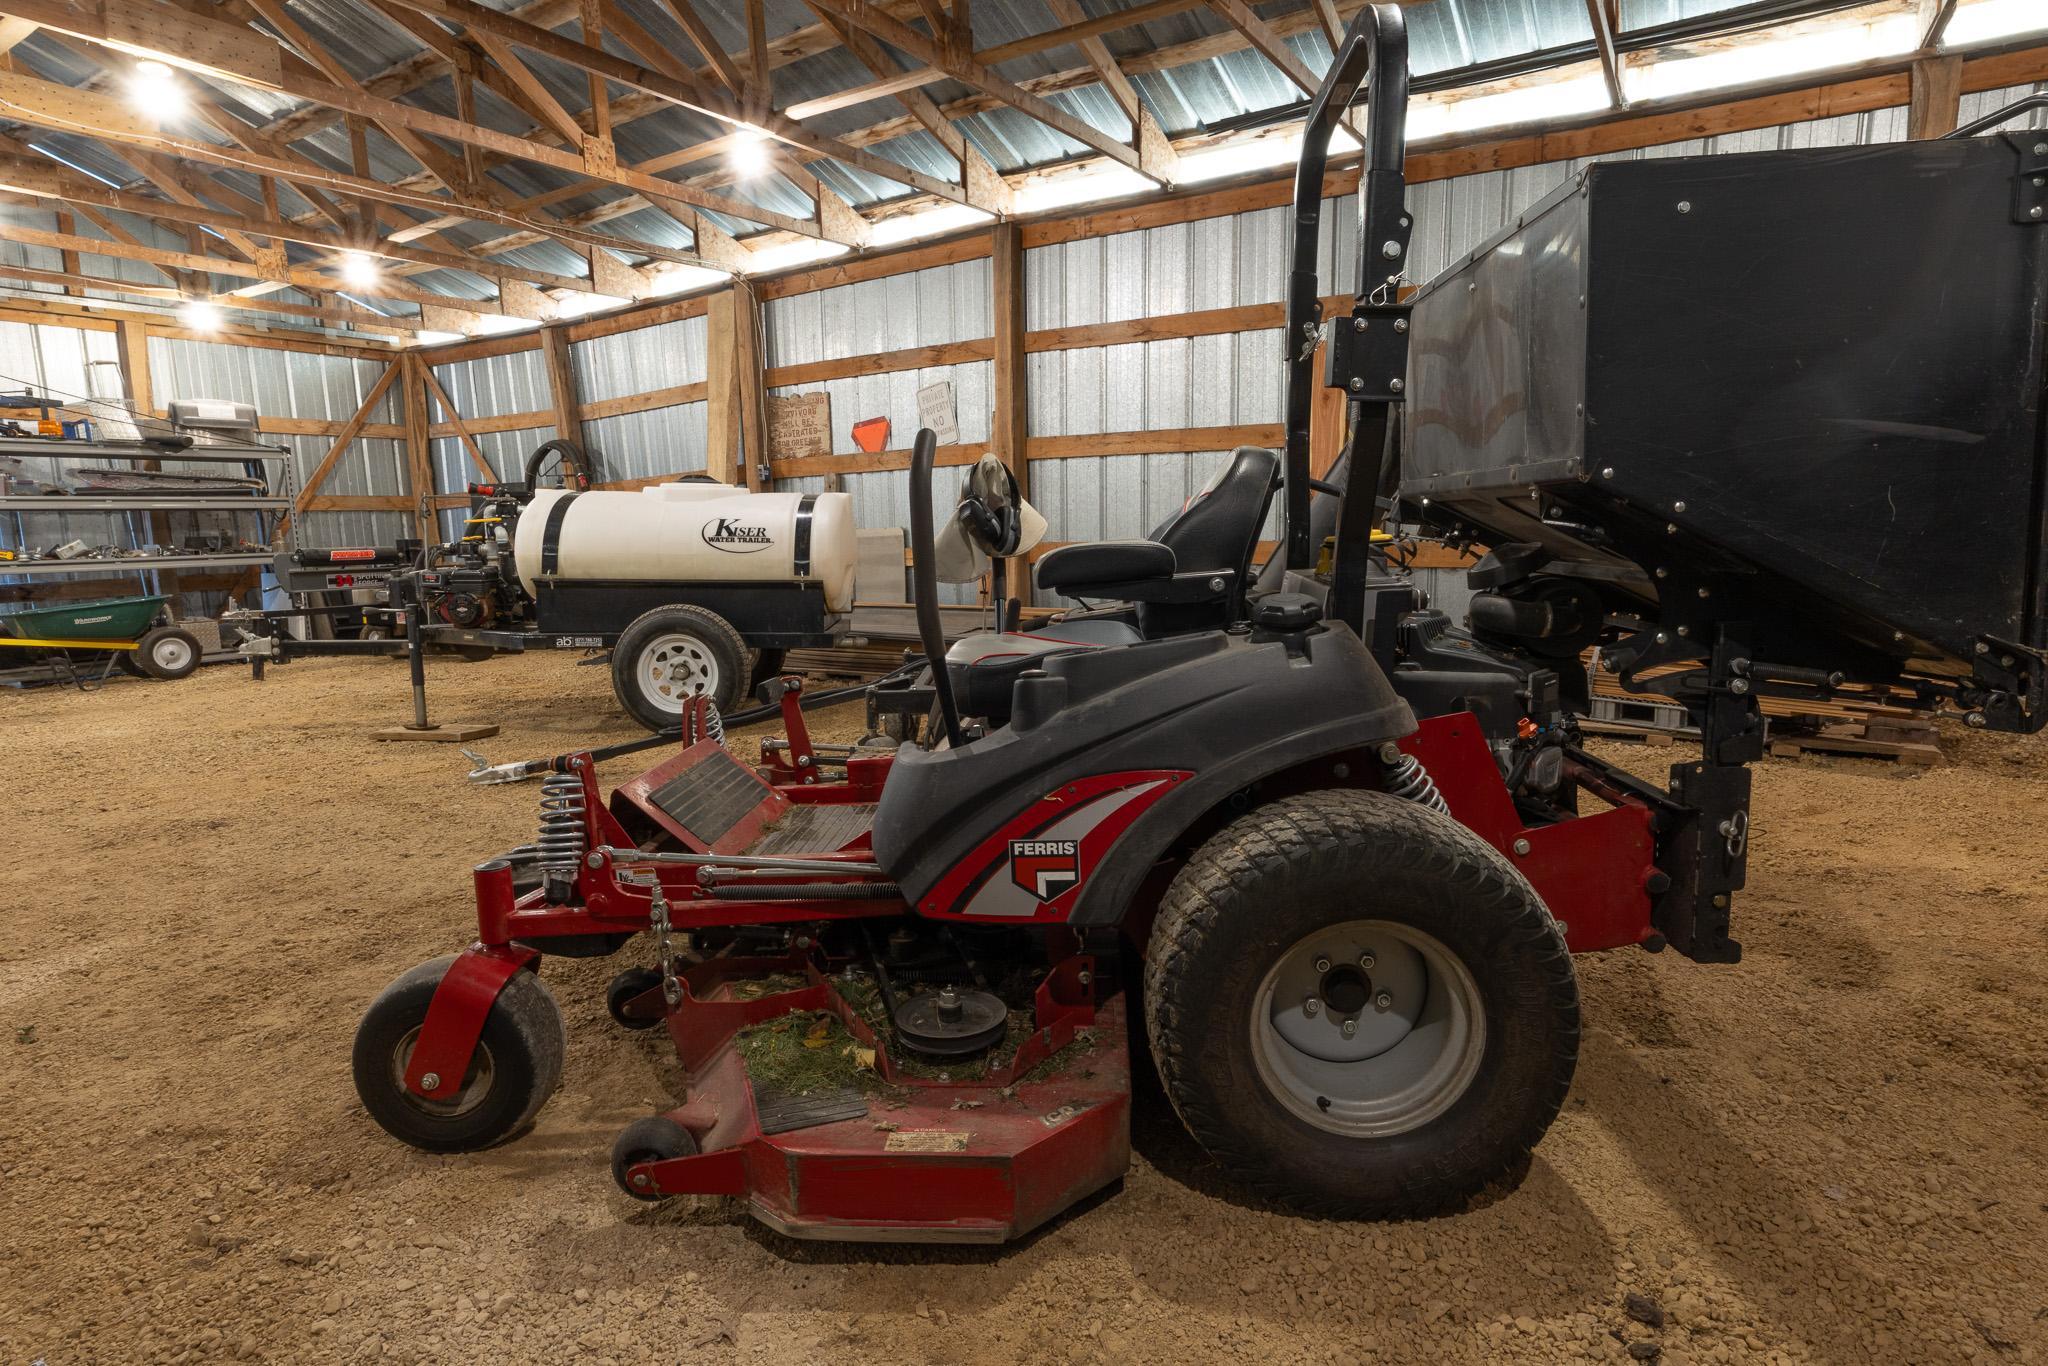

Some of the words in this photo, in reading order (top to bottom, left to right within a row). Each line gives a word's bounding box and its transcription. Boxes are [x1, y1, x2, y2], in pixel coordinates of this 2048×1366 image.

[920, 400, 949, 415] PROPERTY
[801, 418, 811, 426] BE
[932, 415, 945, 427] NO
[335, 574, 353, 588] 34
[1014, 841, 1075, 855] FERRIS
